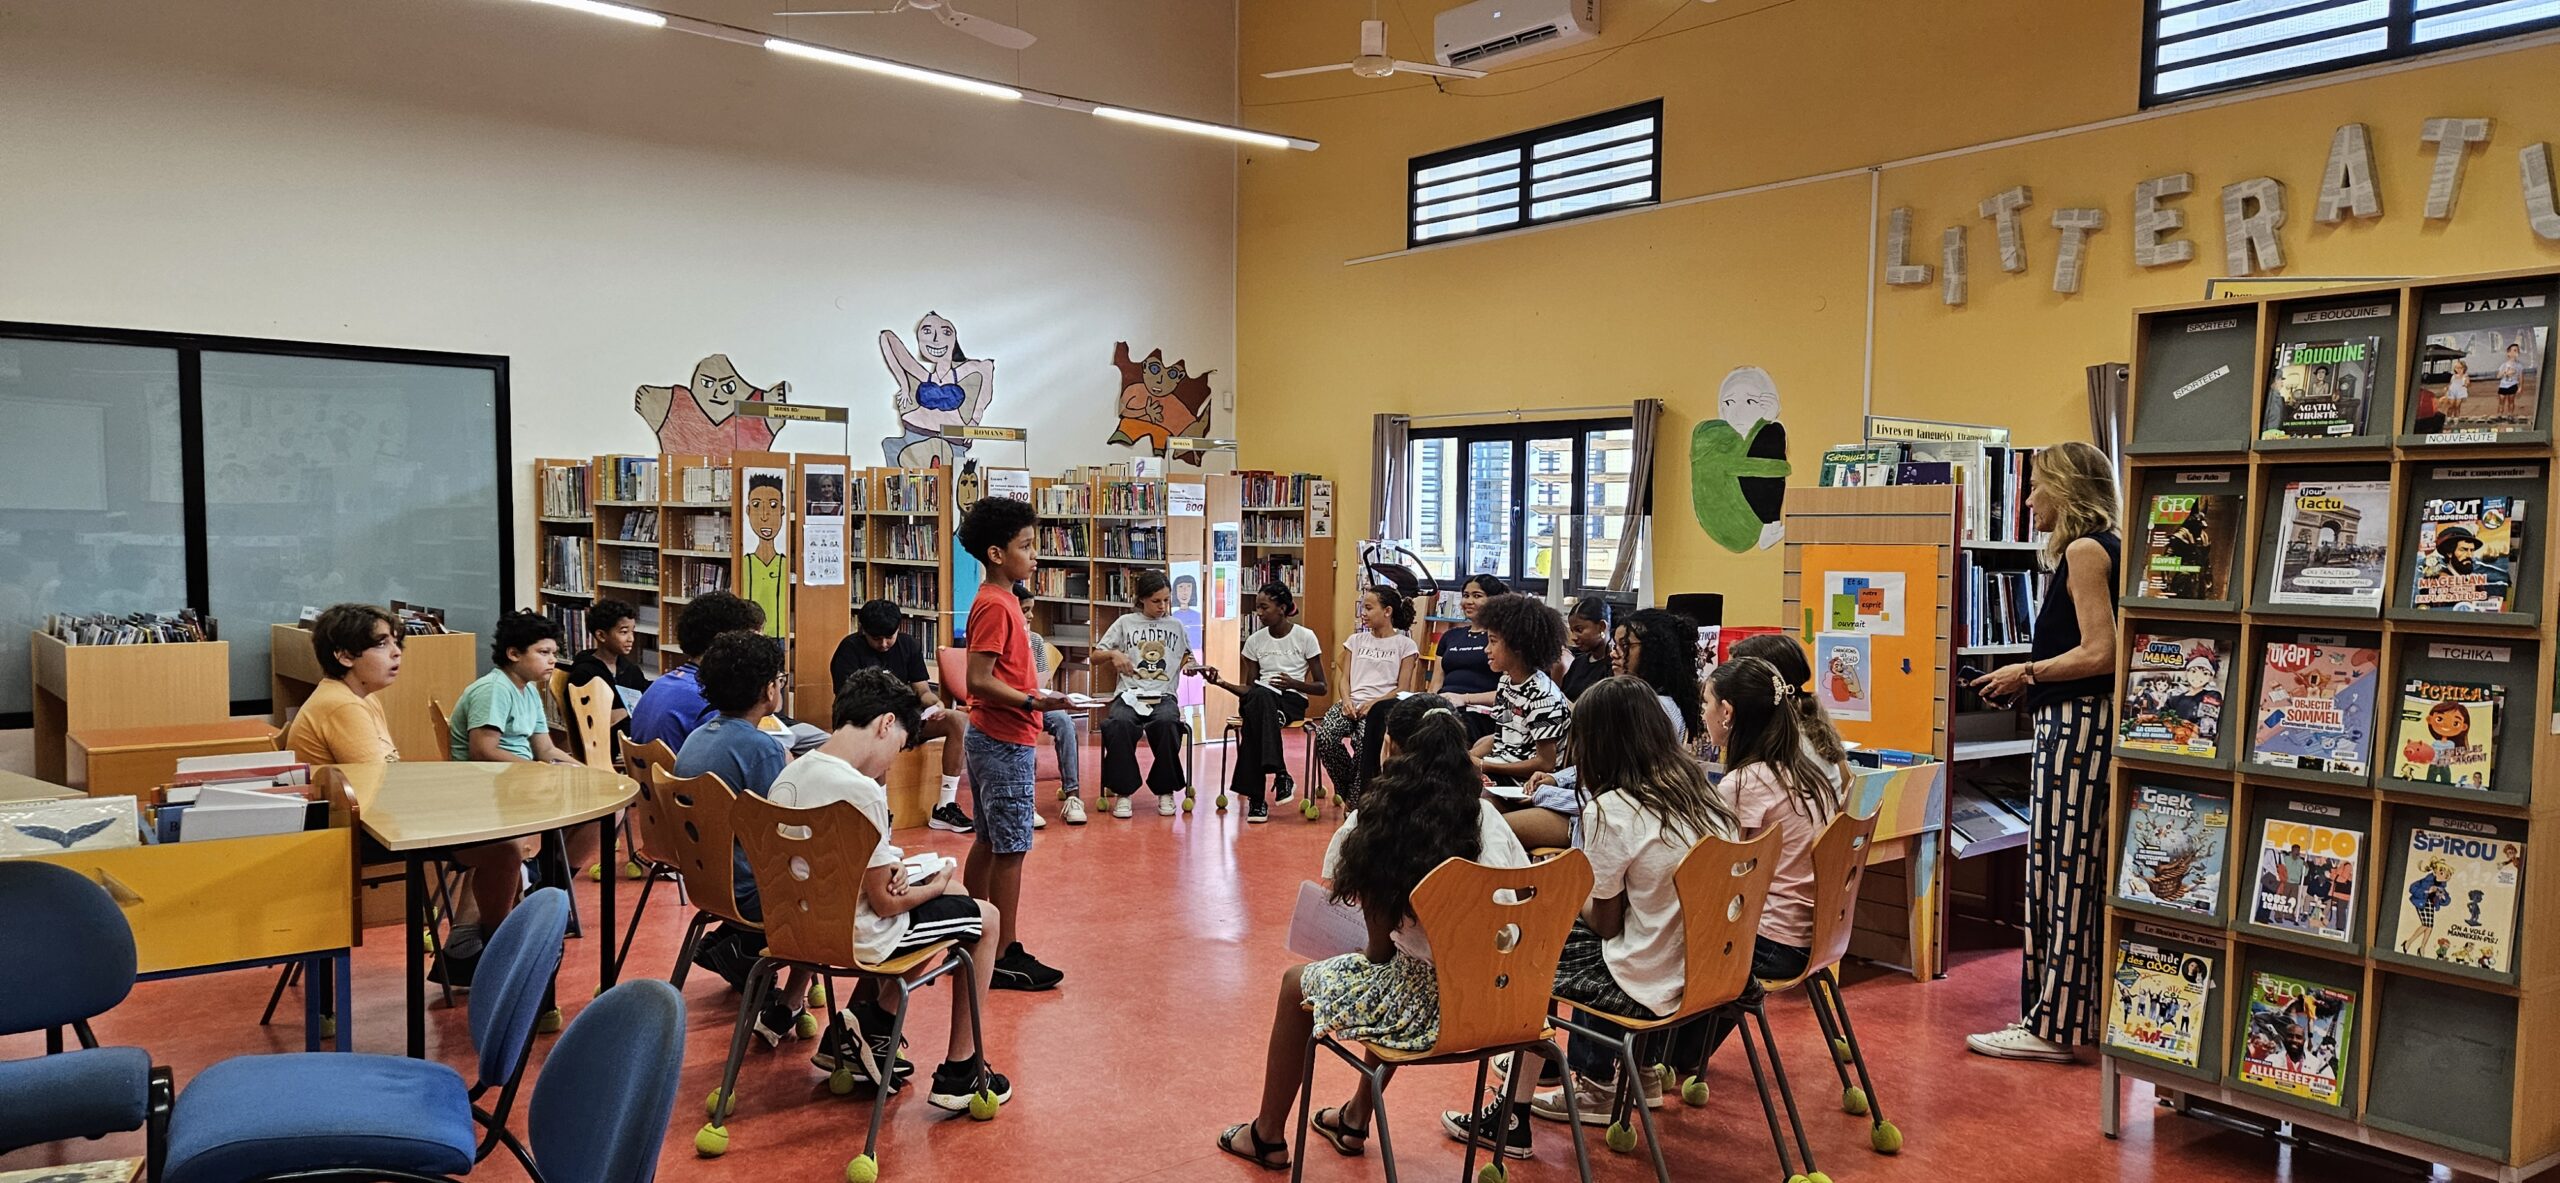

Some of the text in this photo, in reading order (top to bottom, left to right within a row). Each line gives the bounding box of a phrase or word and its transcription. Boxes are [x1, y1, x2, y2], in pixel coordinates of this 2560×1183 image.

[2464, 298, 2525, 312] DADA
[2304, 307, 2379, 321] JE BOUQUINE
[2188, 321, 2236, 331] SPORTEEN
[2276, 343, 2292, 370] JE
[2175, 370, 2221, 397] SPORTEEN
[2299, 402, 2337, 412] AGATHA
[2293, 410, 2339, 420] CHRISTIE
[1876, 424, 1901, 435] Livres
[1903, 428, 1913, 437] en
[1917, 429, 1953, 442] langue(s)
[2470, 468, 2525, 477] comprendre
[1009, 492, 1029, 501] 800
[1186, 503, 1203, 511] 800
[2430, 499, 2481, 514] TOUT
[2418, 574, 2488, 588] MAGELLAN
[1862, 601, 1882, 609] esprit
[1837, 620, 1865, 628] ouvrait
[1126, 629, 1178, 651] ACADEMY
[1358, 648, 1396, 658] HEART
[2144, 652, 2183, 664] MANGA
[2442, 647, 2494, 660] TCHIKA
[2419, 682, 2483, 701] TCHIKA
[2295, 700, 2332, 710] OBJECTIF
[2287, 709, 2341, 725] SOMMEIL
[2142, 788, 2192, 808] Geek
[2150, 804, 2194, 817] Junior
[2302, 803, 2328, 814] TOPO
[2443, 820, 2484, 831] SPIROU
[2266, 821, 2356, 858] TOPO
[2261, 892, 2287, 904] TOUS
[2127, 956, 2177, 975] des ados
[2261, 979, 2305, 998] GEO
